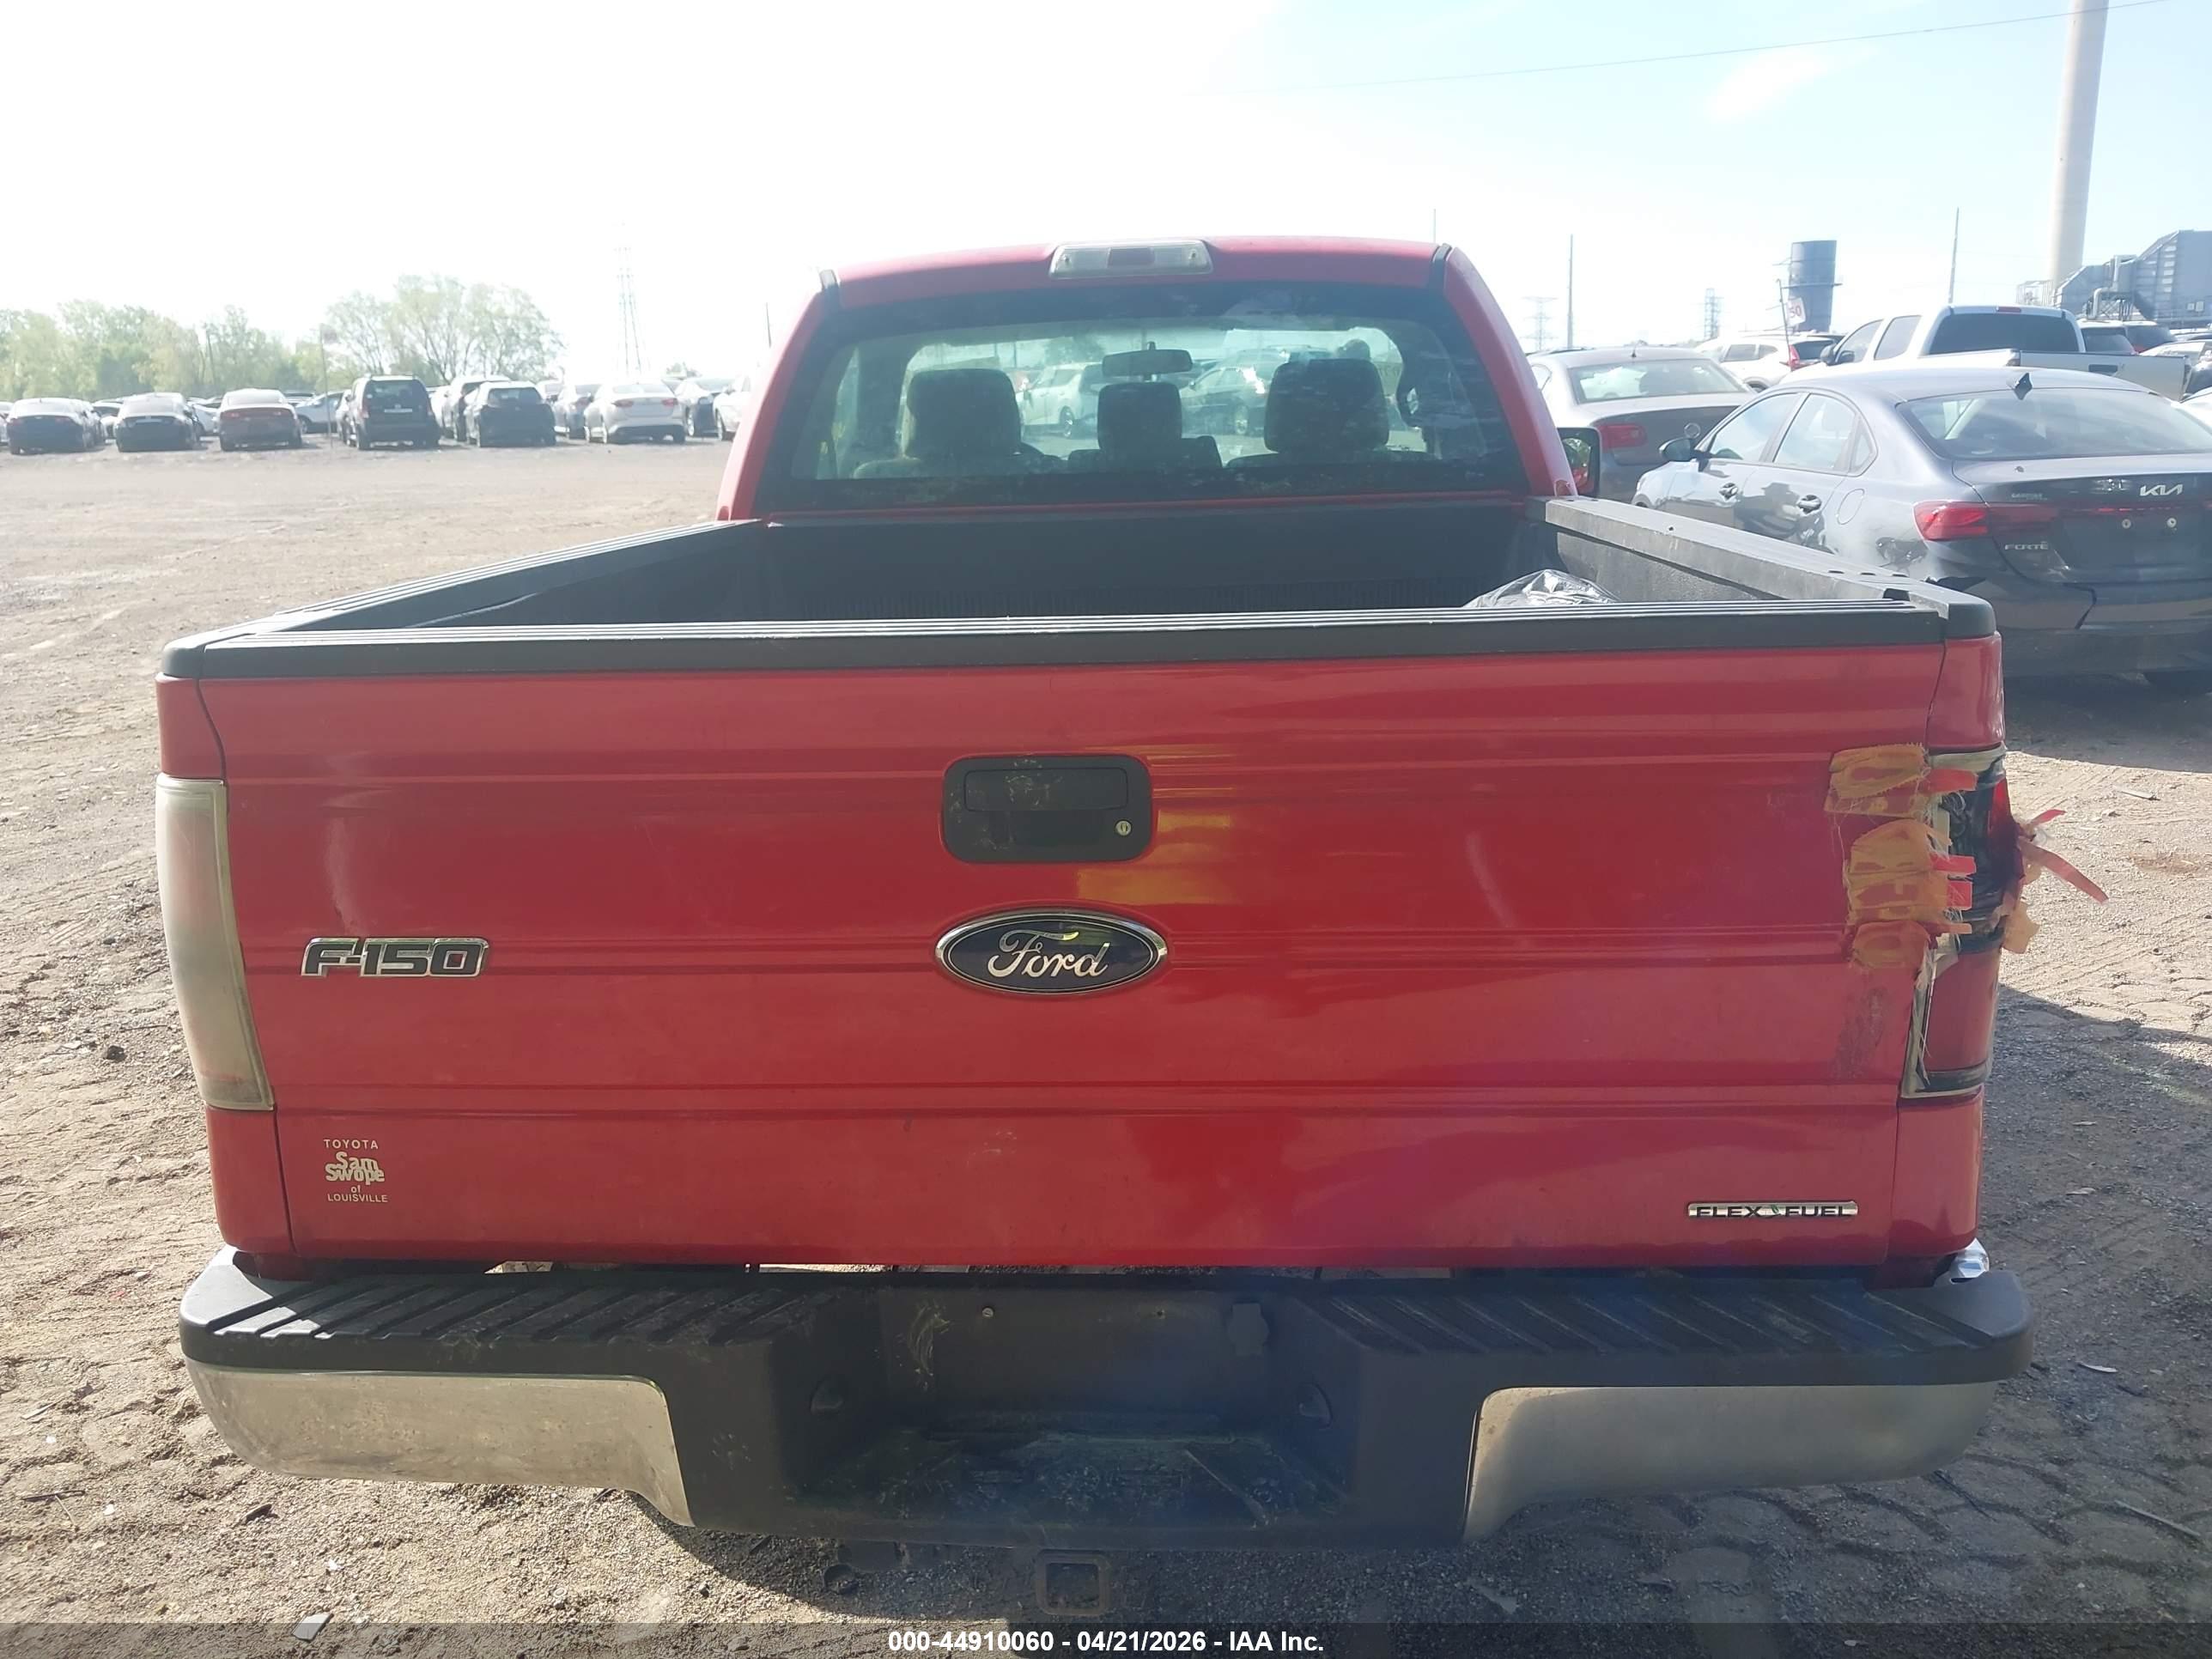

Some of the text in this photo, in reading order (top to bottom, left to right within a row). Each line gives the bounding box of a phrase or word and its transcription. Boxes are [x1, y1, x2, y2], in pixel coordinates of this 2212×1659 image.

[2139, 483, 2184, 496] KIA
[301, 937, 489, 977] F-150
[987, 928, 1109, 978] Ford
[323, 1139, 379, 1150] TOYOTA
[336, 1151, 379, 1170] Sam
[325, 1163, 386, 1186] Swope
[350, 1184, 361, 1194] of
[327, 1193, 389, 1203] LOUISVILLE
[1696, 1206, 1850, 1218] FLEX FUEL
